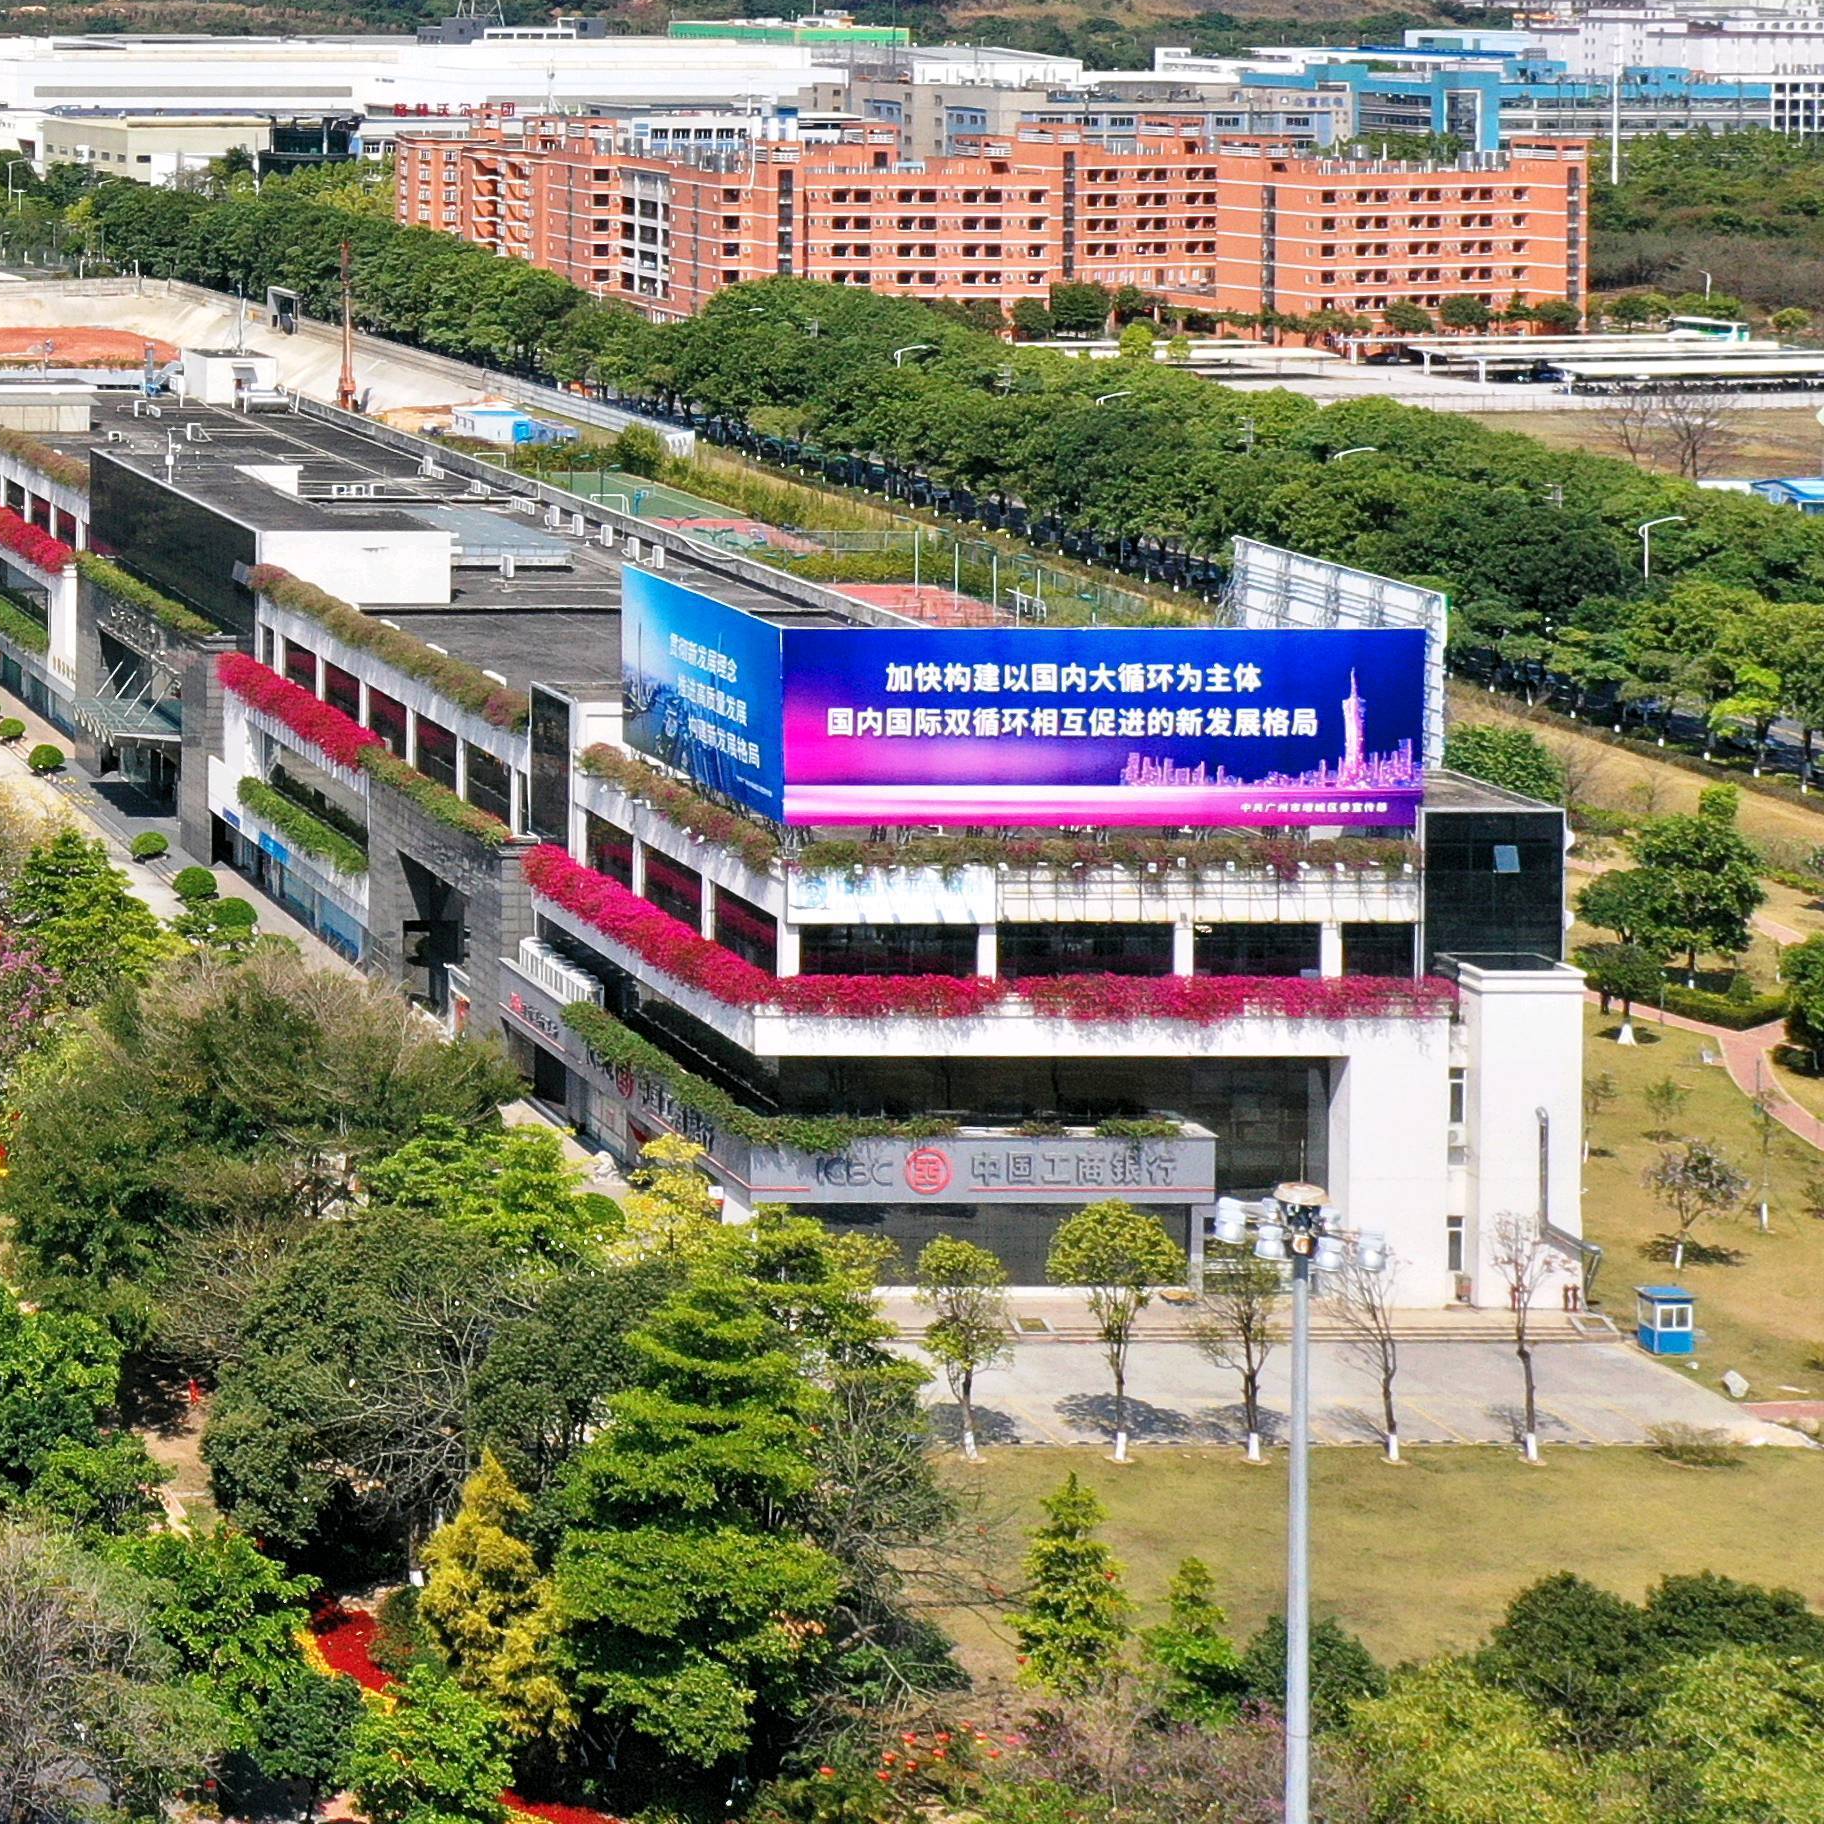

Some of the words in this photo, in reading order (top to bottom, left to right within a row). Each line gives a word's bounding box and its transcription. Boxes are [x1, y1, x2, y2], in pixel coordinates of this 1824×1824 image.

[886, 662, 1262, 693] 加快构建以国内大循环为主体
[827, 707, 1318, 737] 国内国际双循环相互促进的新发展格局
[816, 1155, 894, 1187] ICBC
[970, 1151, 1178, 1186] 中国工商银行
